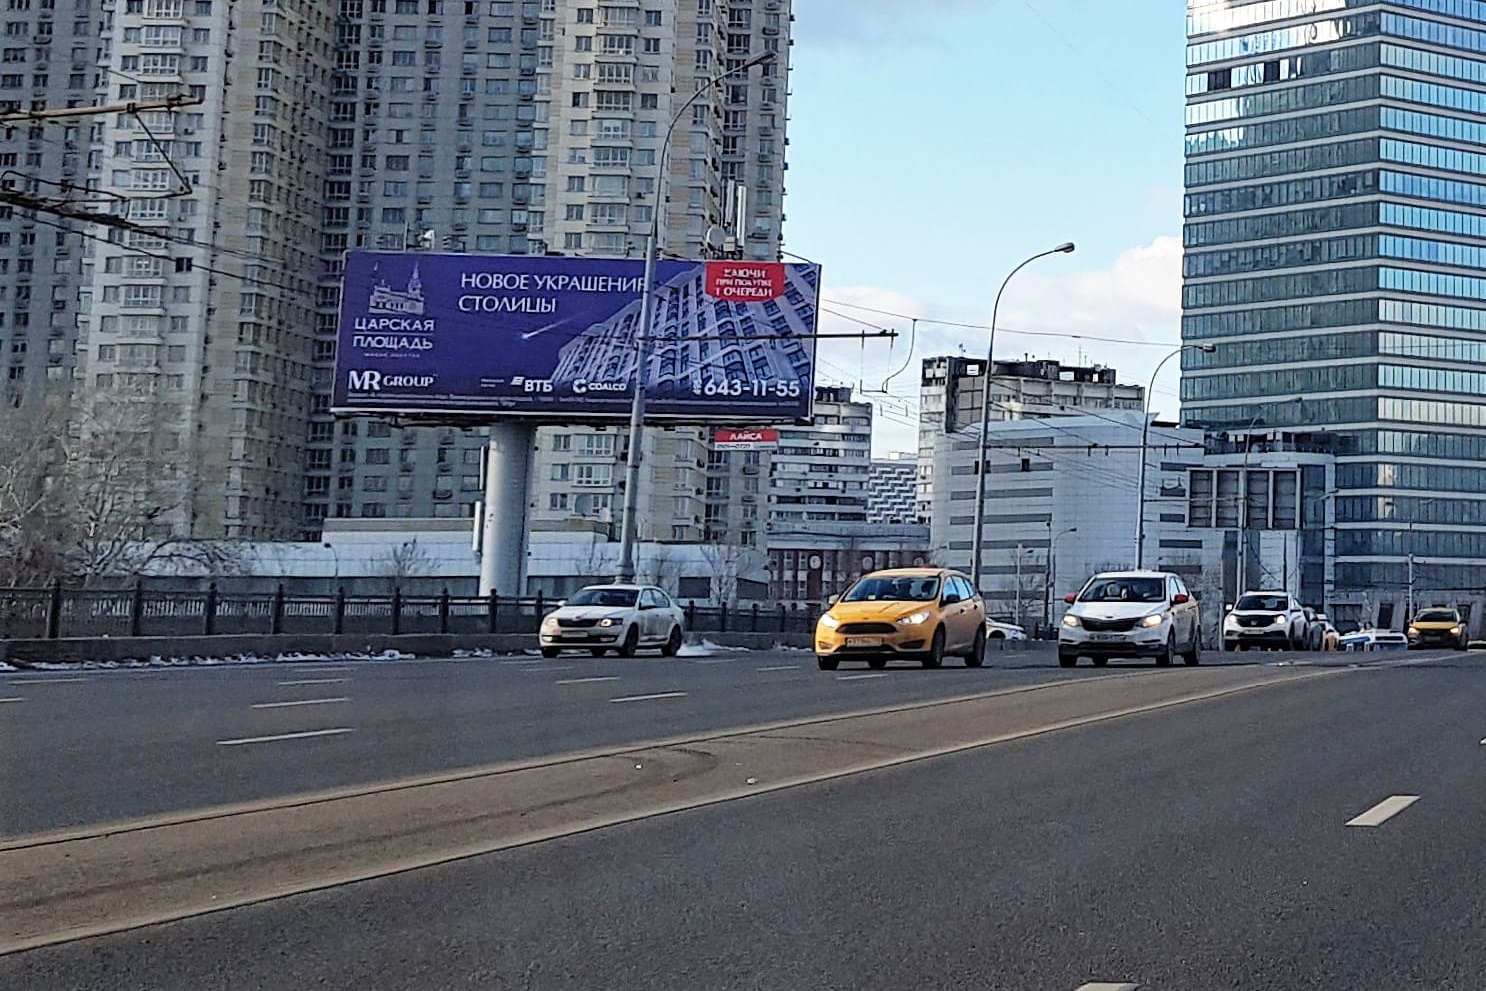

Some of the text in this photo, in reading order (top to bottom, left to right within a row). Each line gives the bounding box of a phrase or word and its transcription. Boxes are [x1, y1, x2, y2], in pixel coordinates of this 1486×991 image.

[460, 272, 530, 290] НОВОЕ
[723, 287, 773, 297] ОЧЕРЕДИ
[458, 294, 556, 313] СТОЛИЦЫ
[353, 317, 435, 332] ЦАРСКАЯ
[352, 335, 433, 351] ПЛОЩАДЬ
[348, 370, 434, 391] MR GROUP
[524, 379, 554, 392] ВТБ
[704, 378, 800, 398] 643-11-55
